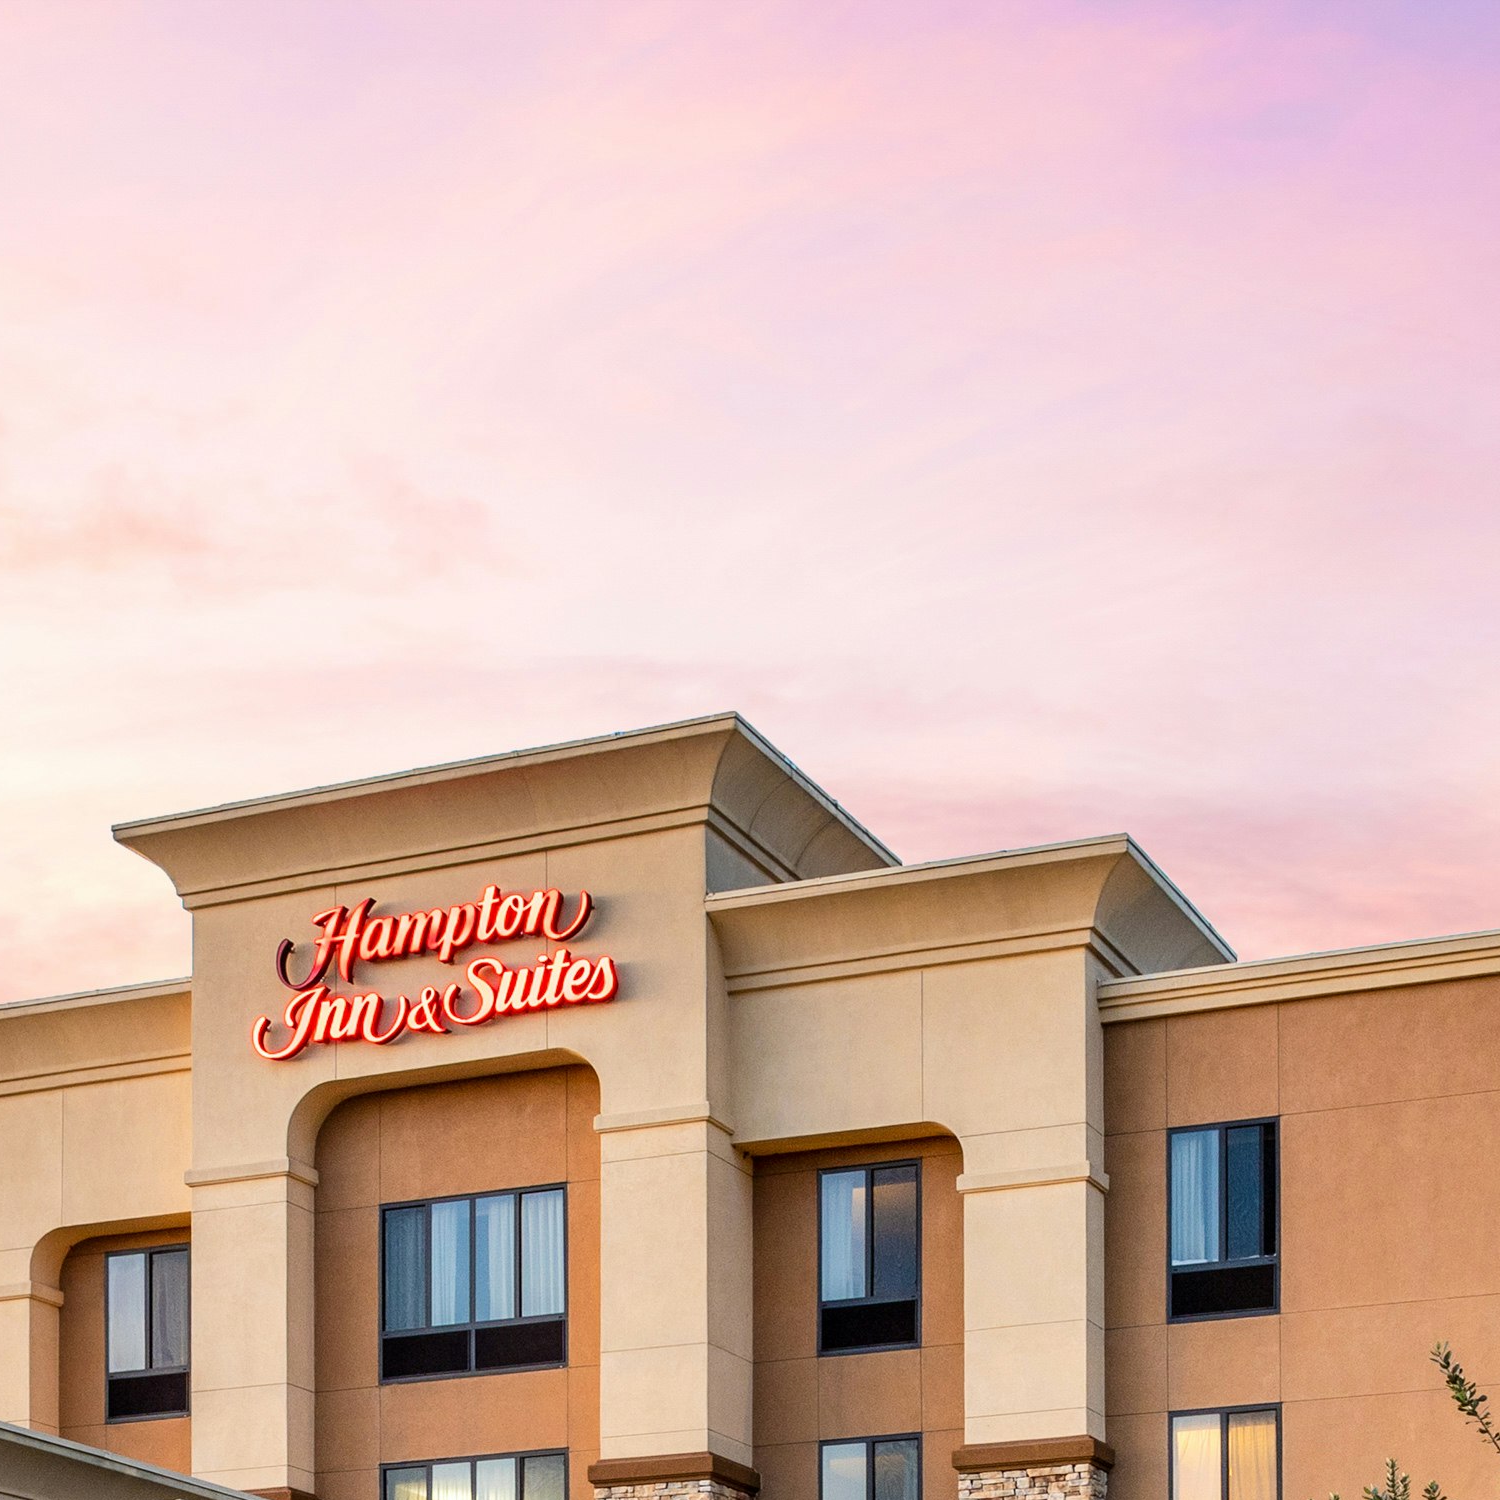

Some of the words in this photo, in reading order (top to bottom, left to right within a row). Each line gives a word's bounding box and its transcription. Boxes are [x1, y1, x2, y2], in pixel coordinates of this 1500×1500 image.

[276, 884, 593, 991] Hampton
[252, 986, 407, 1061] Inn
[407, 986, 450, 1034] &
[444, 949, 620, 1026] Suites
